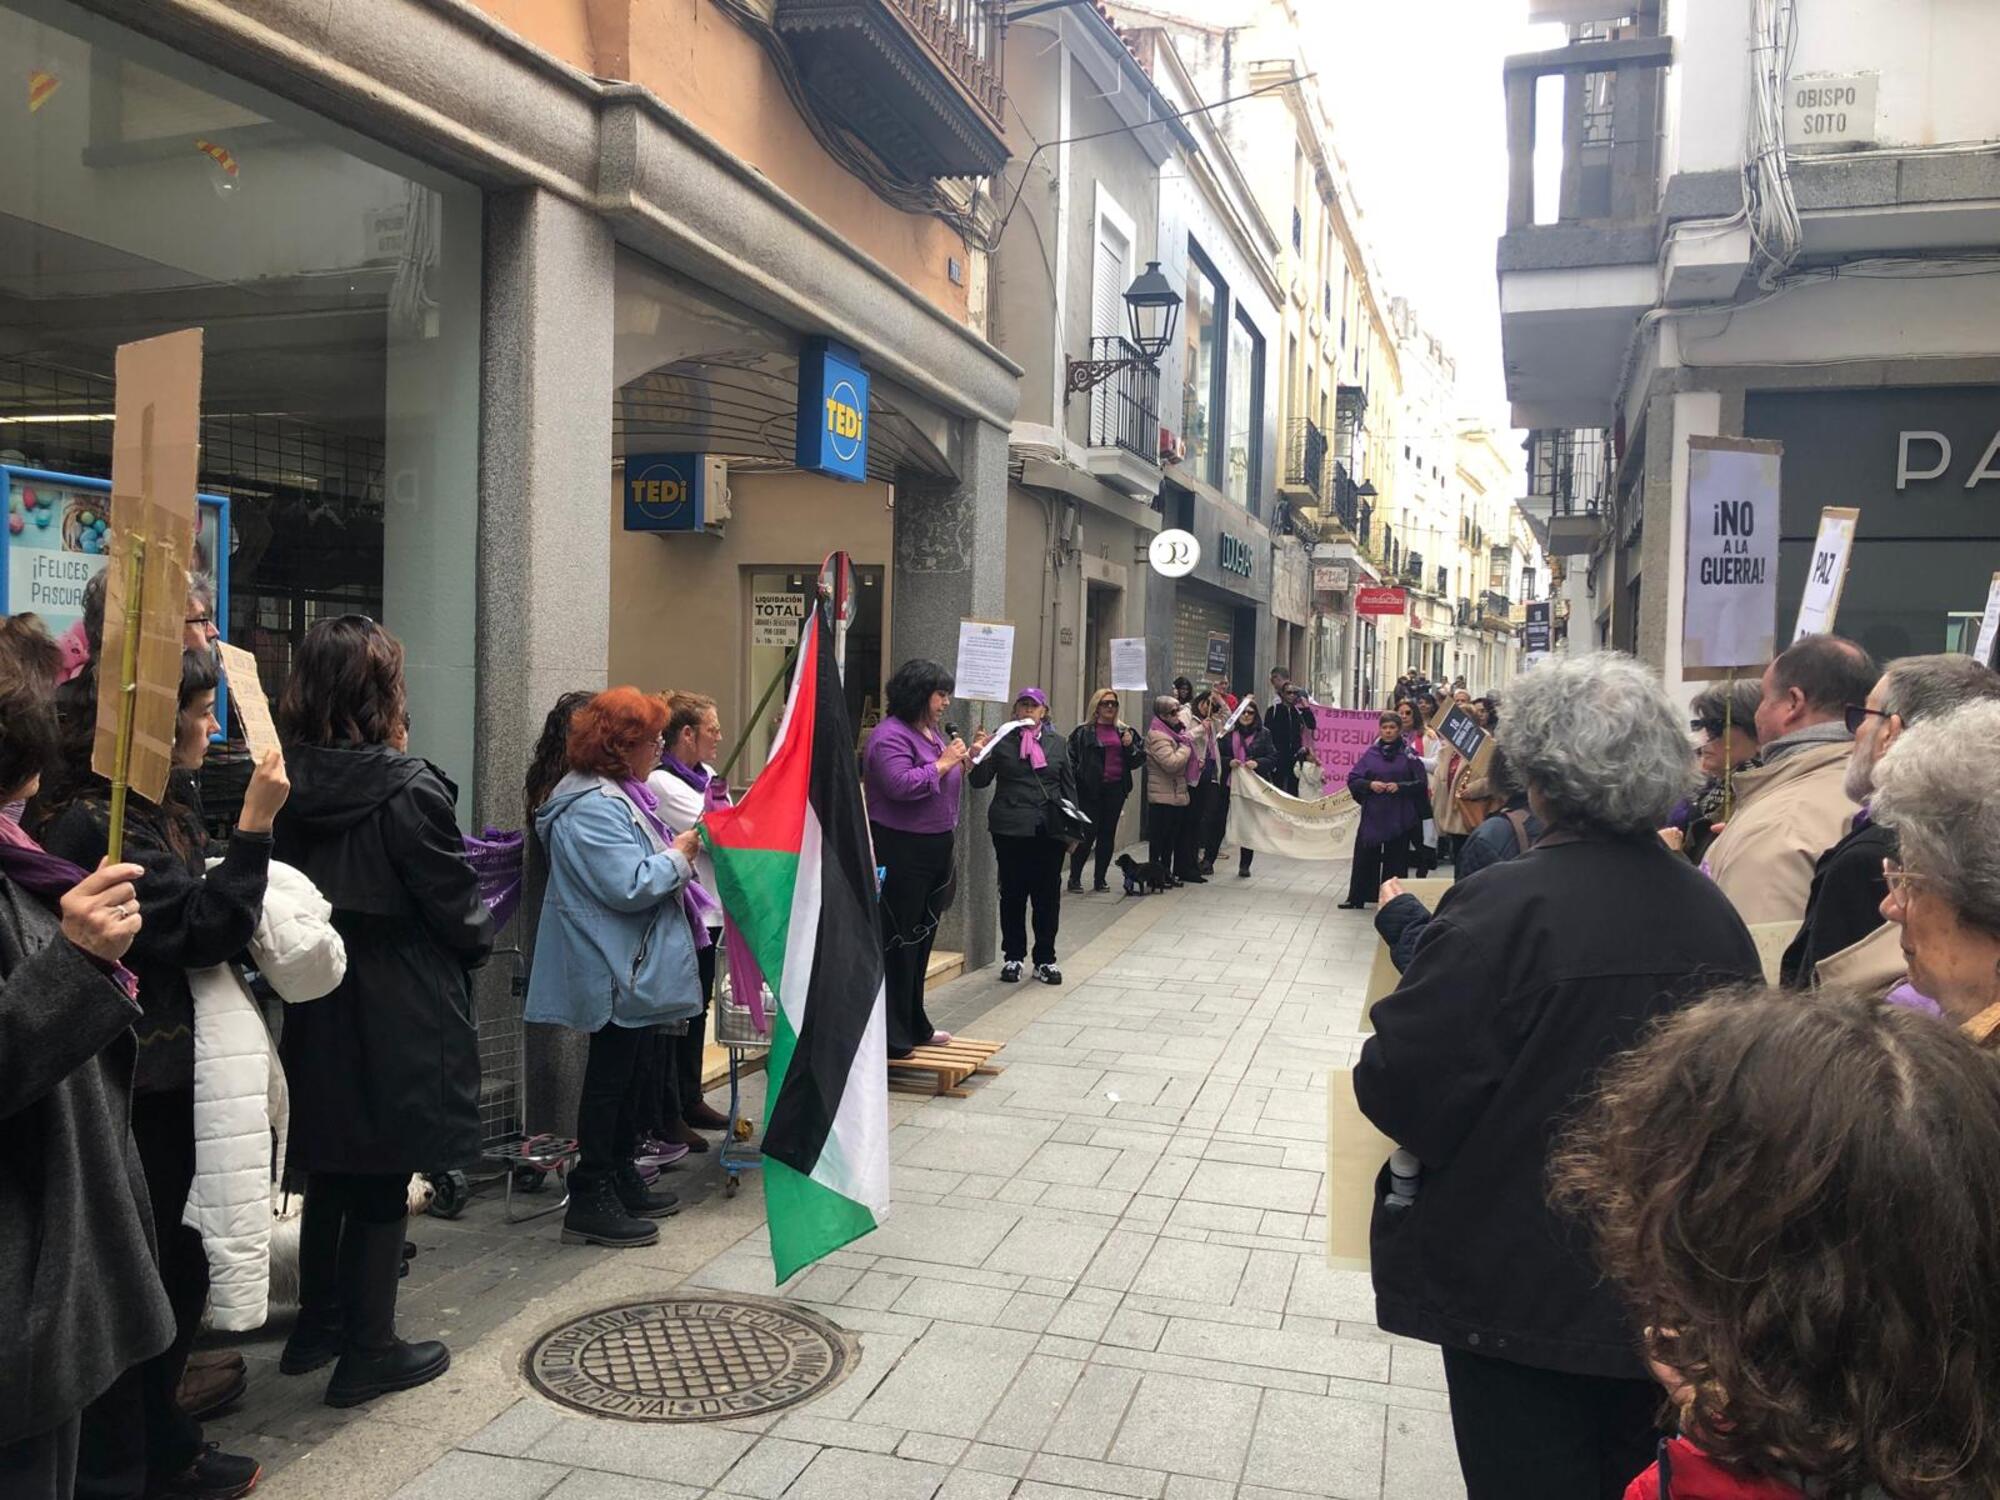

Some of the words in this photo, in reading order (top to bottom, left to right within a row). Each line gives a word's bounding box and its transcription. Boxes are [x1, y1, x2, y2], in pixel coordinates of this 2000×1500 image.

[1796, 87, 1856, 108] OBISPO
[1803, 113, 1847, 134] SOTO
[827, 398, 862, 441] TEDi
[632, 480, 687, 502] TEDi
[1713, 500, 1754, 536] ¡NO
[1723, 539, 1732, 554] A
[1735, 539, 1749, 554] LA
[1700, 556, 1765, 585] GUERRA!
[1812, 551, 1837, 585] PAZ
[32, 582, 82, 606] PASCUA
[755, 595, 802, 604] LIQUIDACIÓN
[755, 604, 802, 616] TOTAL
[700, 1395, 750, 1415] DE
